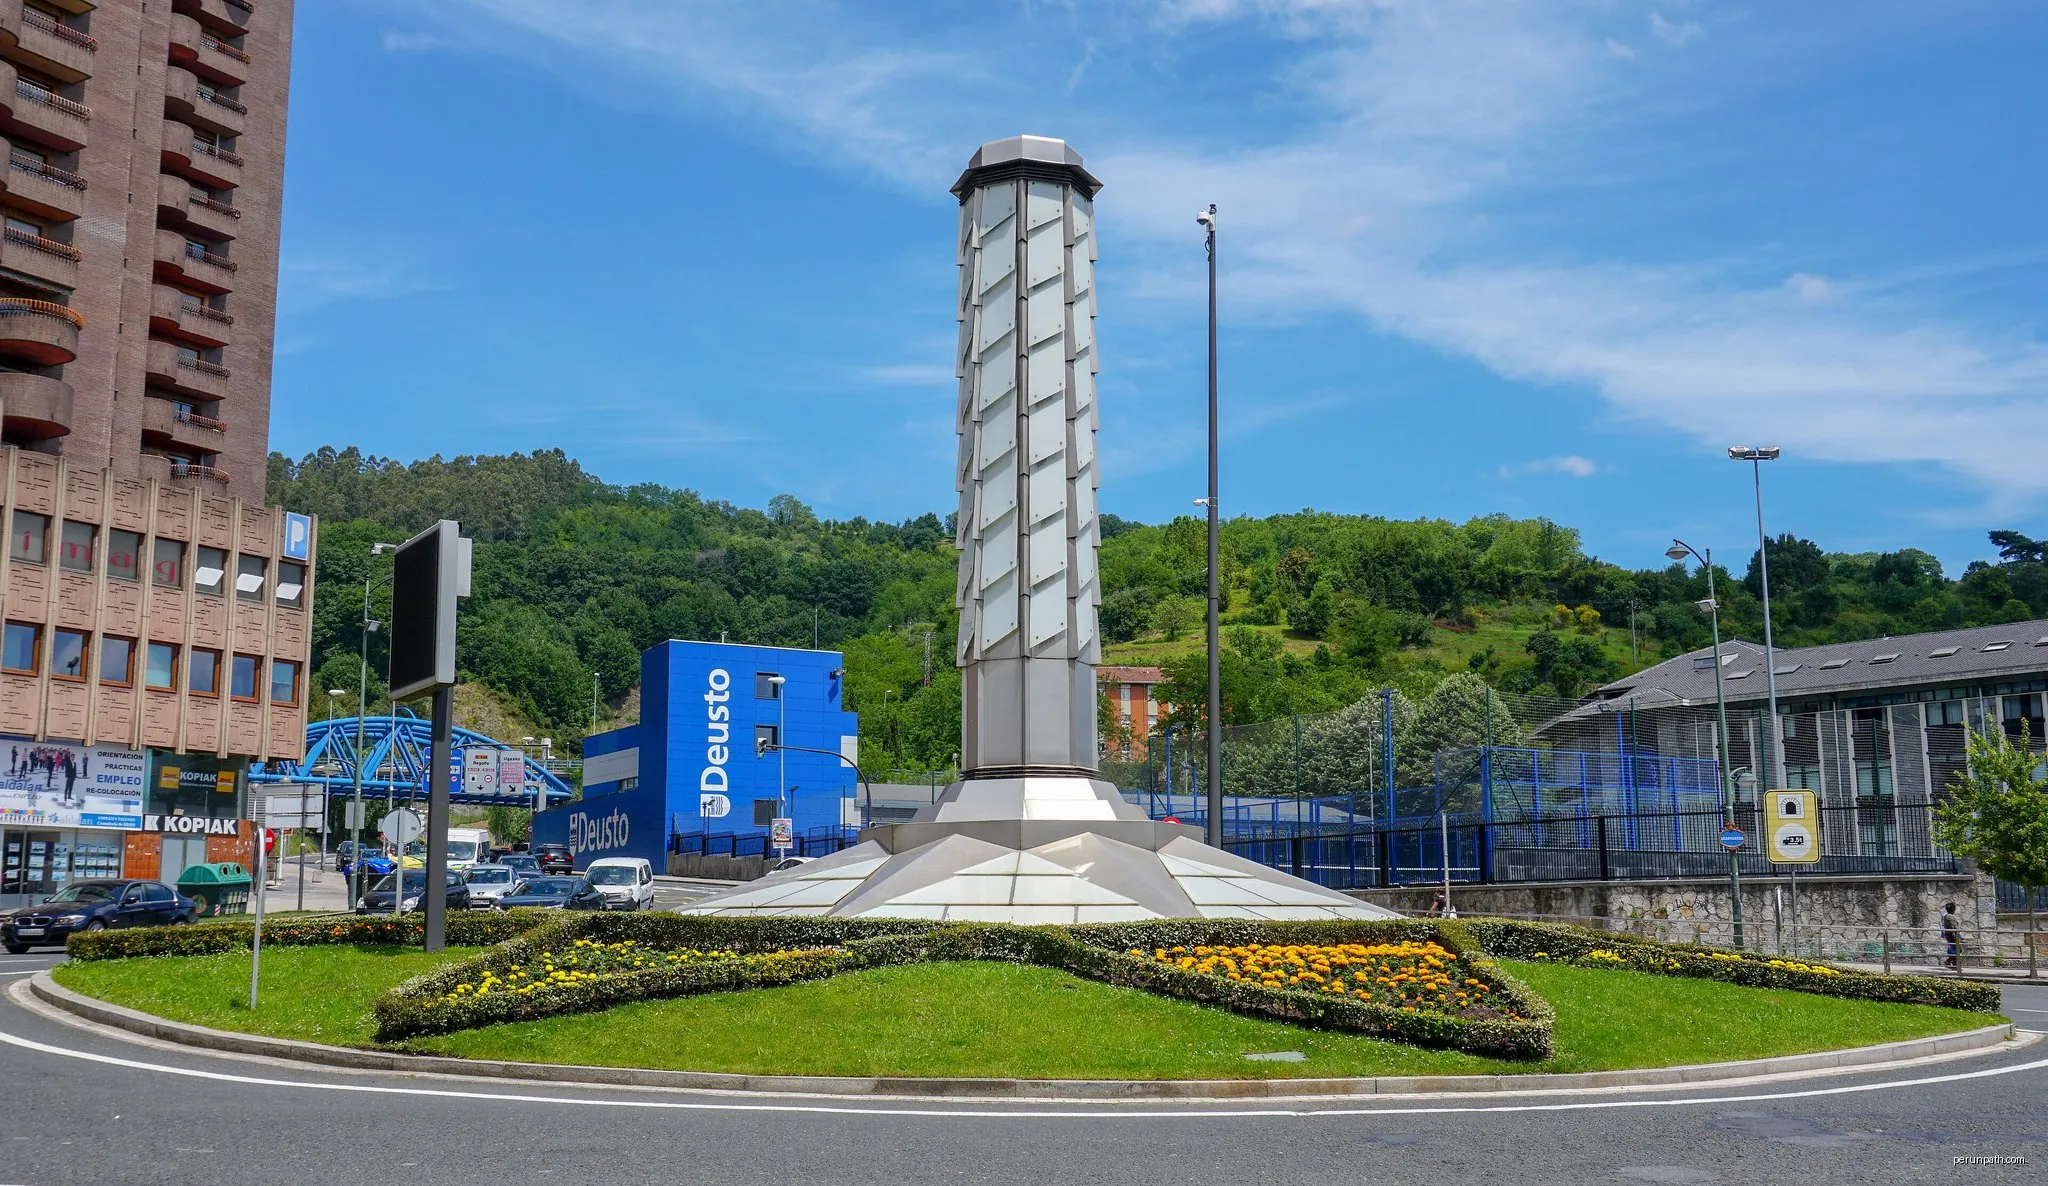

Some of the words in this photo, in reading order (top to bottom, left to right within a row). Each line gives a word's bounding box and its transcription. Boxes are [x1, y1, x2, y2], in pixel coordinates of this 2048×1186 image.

[290, 520, 304, 552] P
[700, 668, 731, 792] Deusto
[96, 774, 142, 786] EMPLEO
[180, 771, 217, 782] KOPIAK
[164, 816, 236, 834] KOPIAK
[577, 806, 629, 853] Deusto
